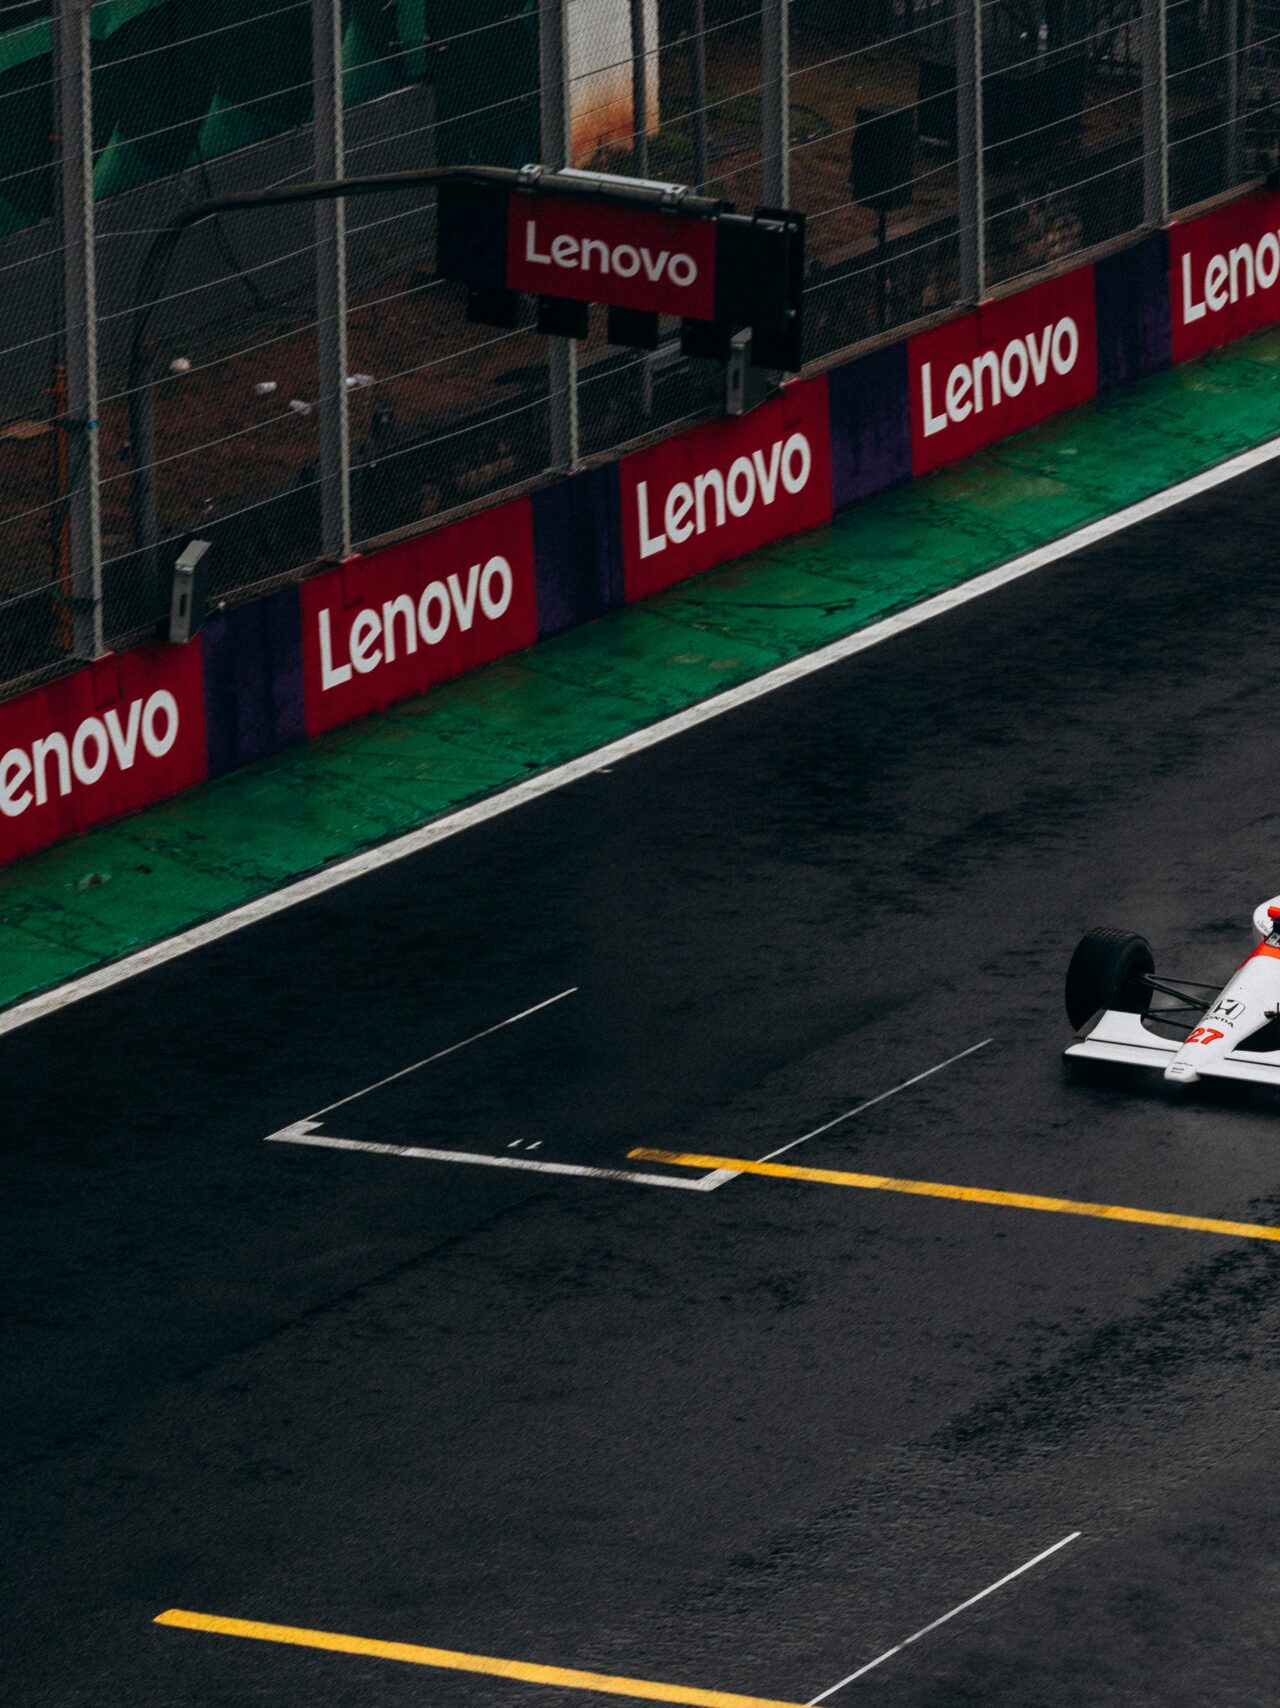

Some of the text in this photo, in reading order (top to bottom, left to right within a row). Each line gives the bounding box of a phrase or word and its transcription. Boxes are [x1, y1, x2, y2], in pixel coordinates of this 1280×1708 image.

[526, 221, 697, 287] Lenovo
[921, 316, 1079, 437] Lenovo
[636, 432, 811, 559] Lenovo
[318, 556, 513, 691] Lenovo
[1183, 1027, 1225, 1046] 27
